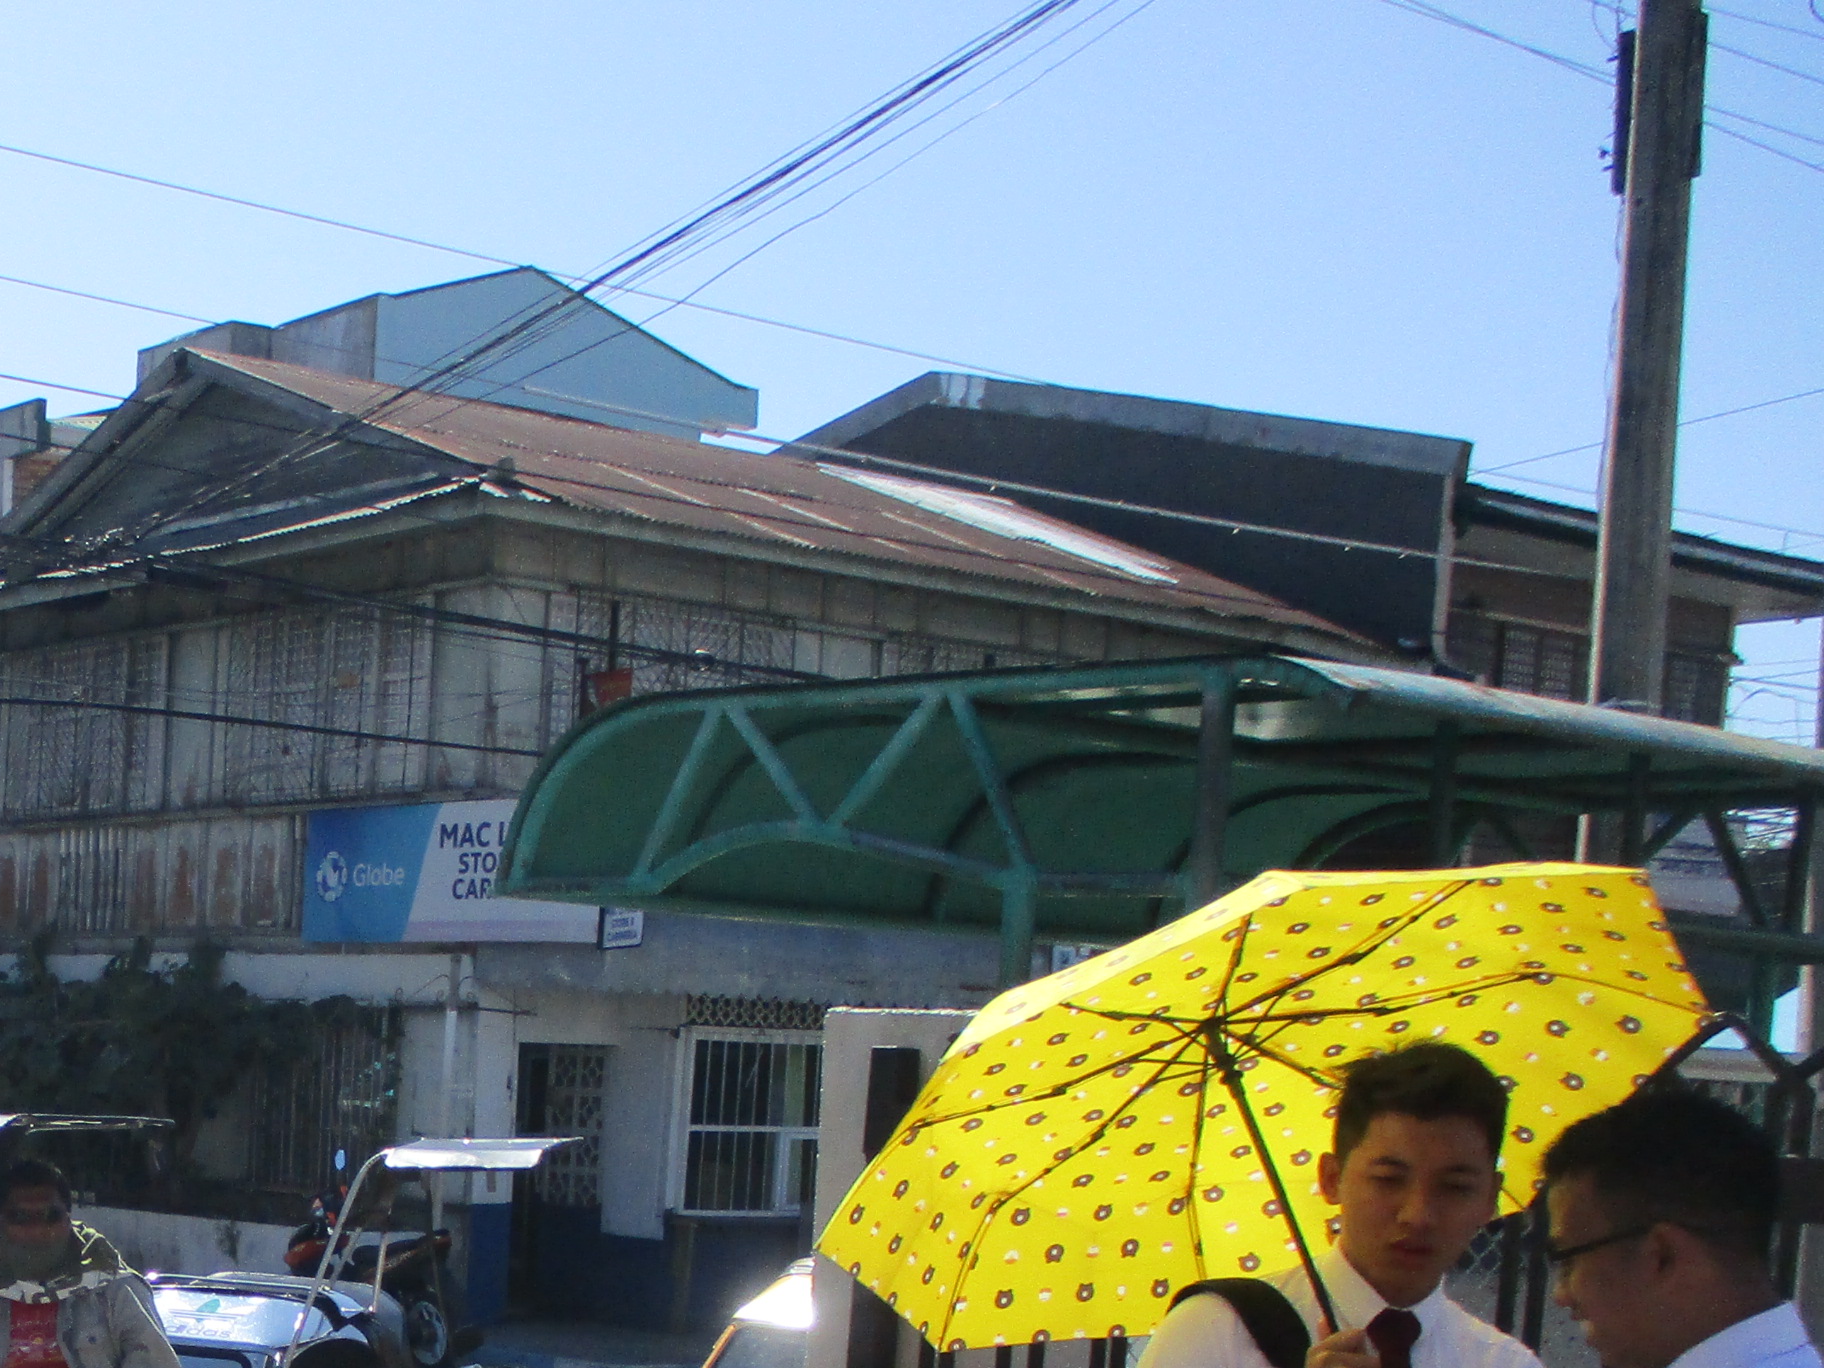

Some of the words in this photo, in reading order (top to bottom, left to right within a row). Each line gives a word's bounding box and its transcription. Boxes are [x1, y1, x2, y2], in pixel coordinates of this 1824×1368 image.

[439, 821, 492, 849] MAC
[497, 821, 506, 847] L
[353, 862, 405, 887] Globe
[458, 851, 498, 875] STO
[451, 877, 493, 900] CAR
